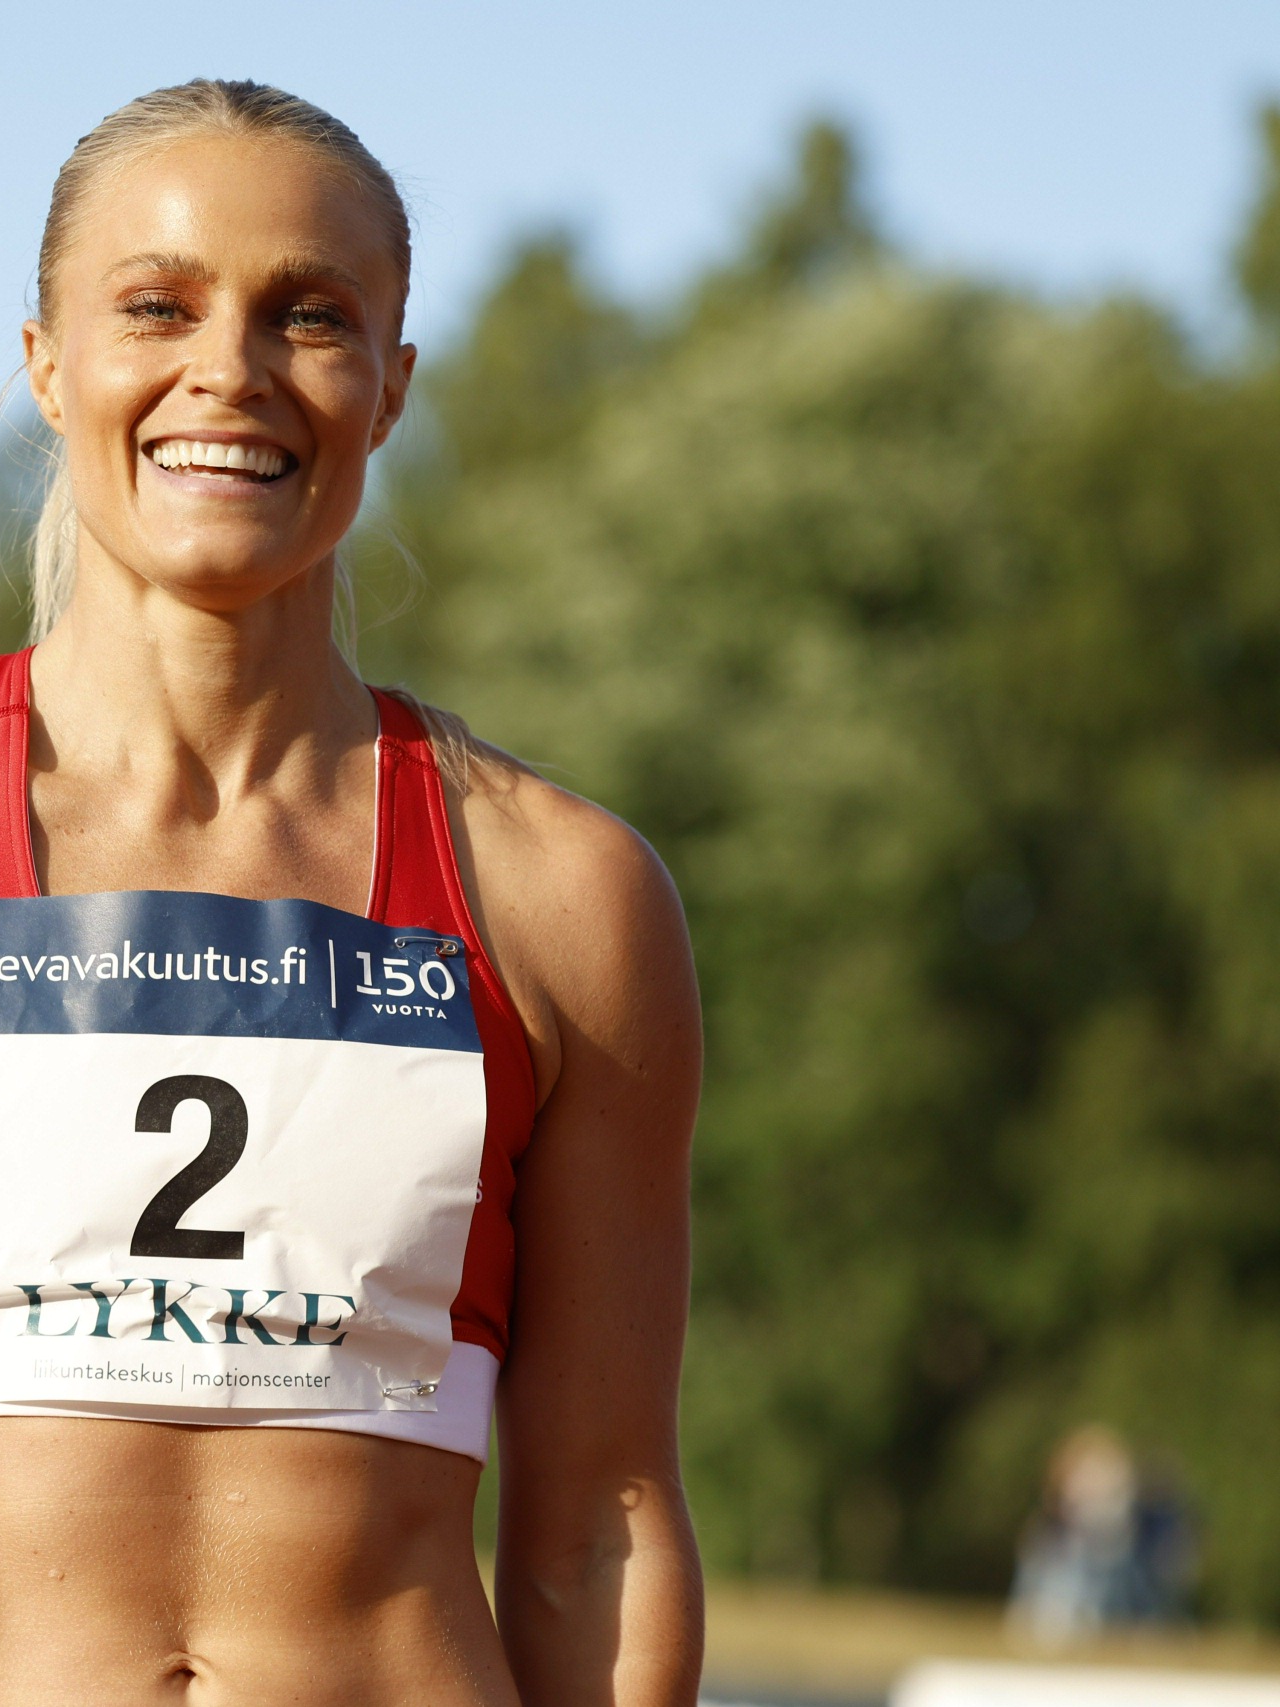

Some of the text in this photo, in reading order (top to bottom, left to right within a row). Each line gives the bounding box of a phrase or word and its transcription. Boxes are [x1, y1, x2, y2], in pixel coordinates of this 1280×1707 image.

[356, 951, 456, 1001] 150
[371, 1003, 448, 1020] VUOTTA
[129, 1074, 249, 1260] 2
[15, 1277, 358, 1347] LYKKE
[32, 1359, 331, 1389] liikuntakeskus motionscenter
